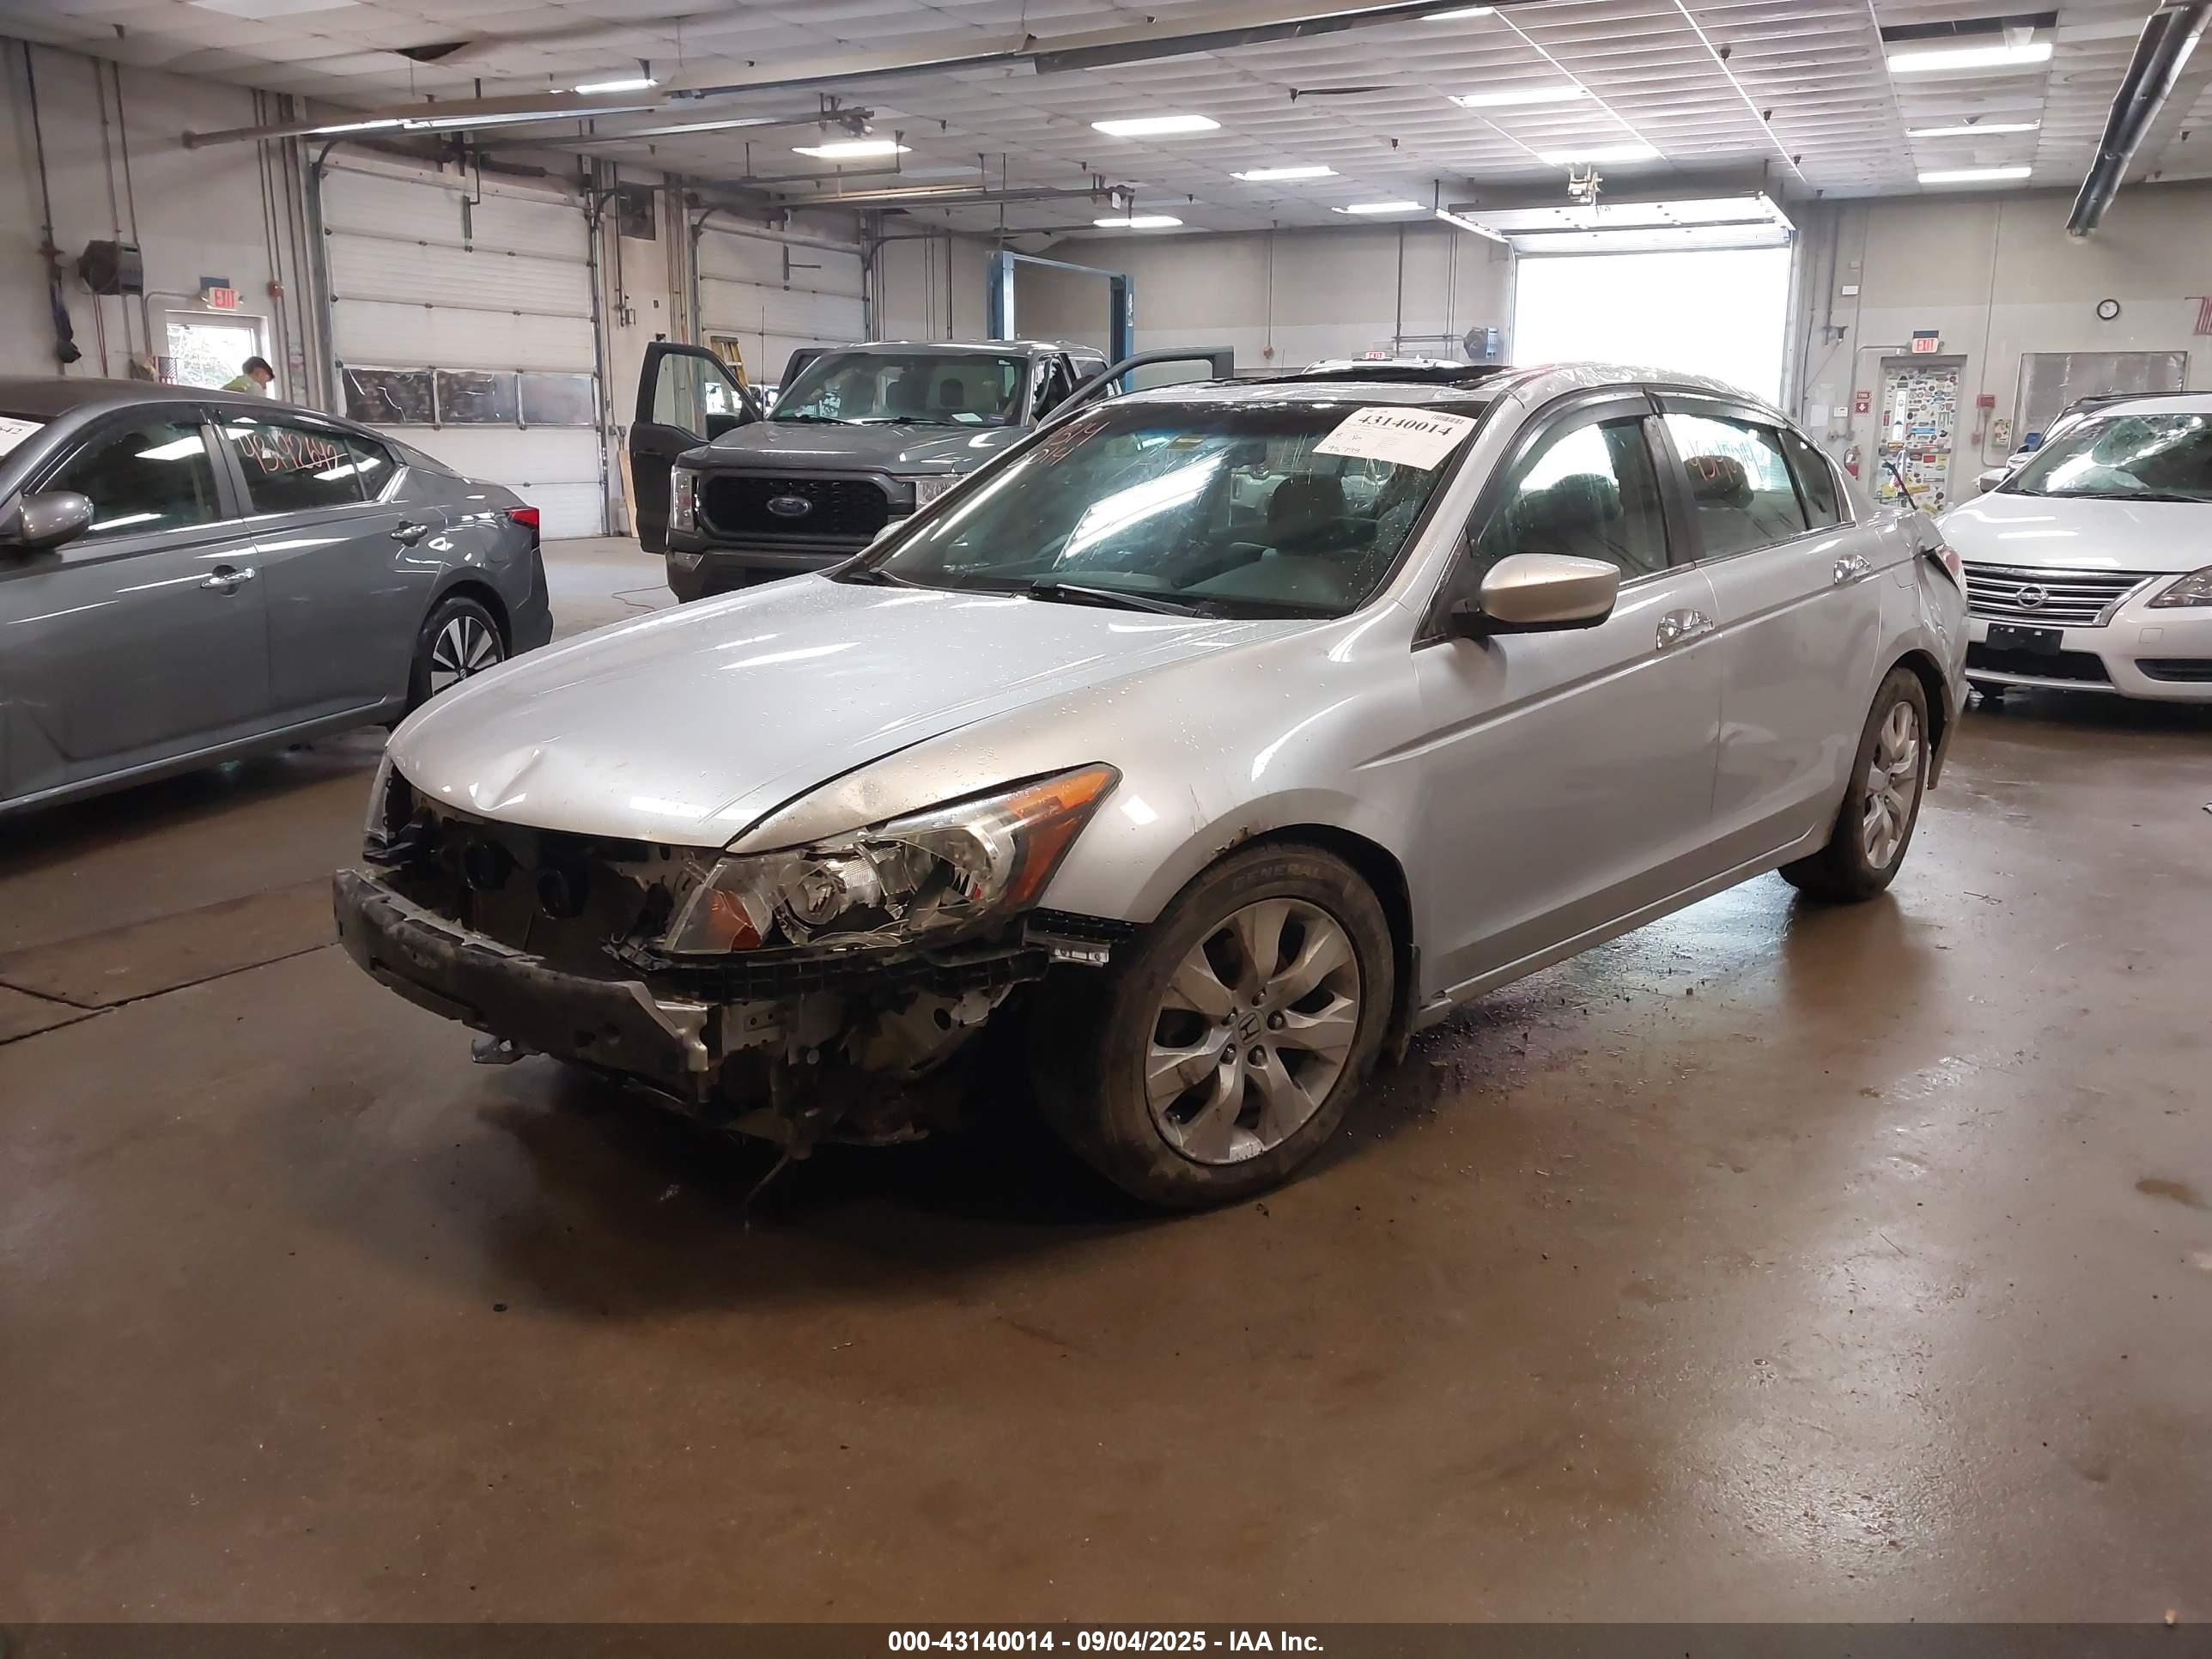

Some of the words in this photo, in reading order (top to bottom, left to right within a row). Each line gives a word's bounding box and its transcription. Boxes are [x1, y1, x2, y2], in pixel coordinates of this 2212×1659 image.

[215, 289, 234, 308] EXIT
[1917, 339, 1935, 352] EXIT
[1358, 415, 1453, 436] 43140014
